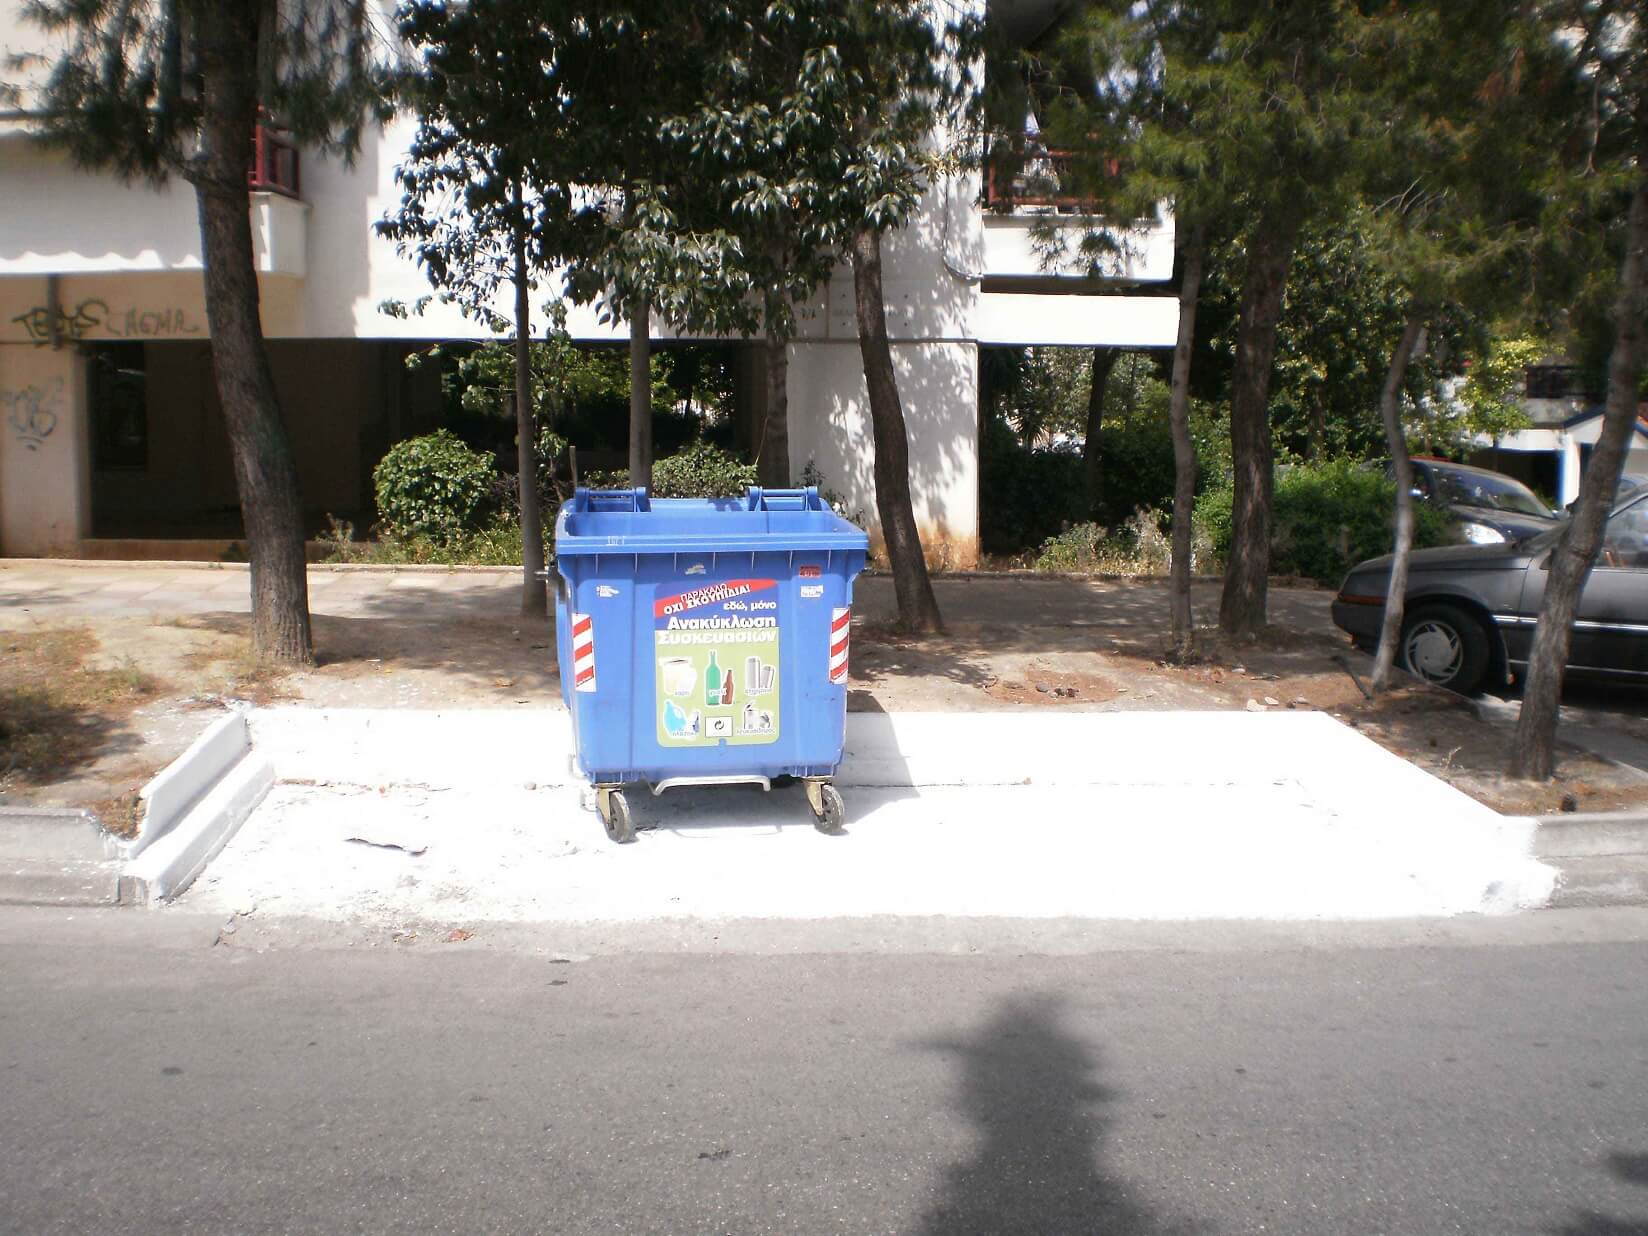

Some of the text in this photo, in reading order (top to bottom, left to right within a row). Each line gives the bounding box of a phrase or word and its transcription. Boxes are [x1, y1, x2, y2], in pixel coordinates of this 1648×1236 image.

[663, 602, 684, 614] ΟΧΙ
[750, 601, 777, 611] μόνο
[667, 615, 776, 629] Ανακύκλωση
[657, 630, 776, 644] Συσκευασιών
